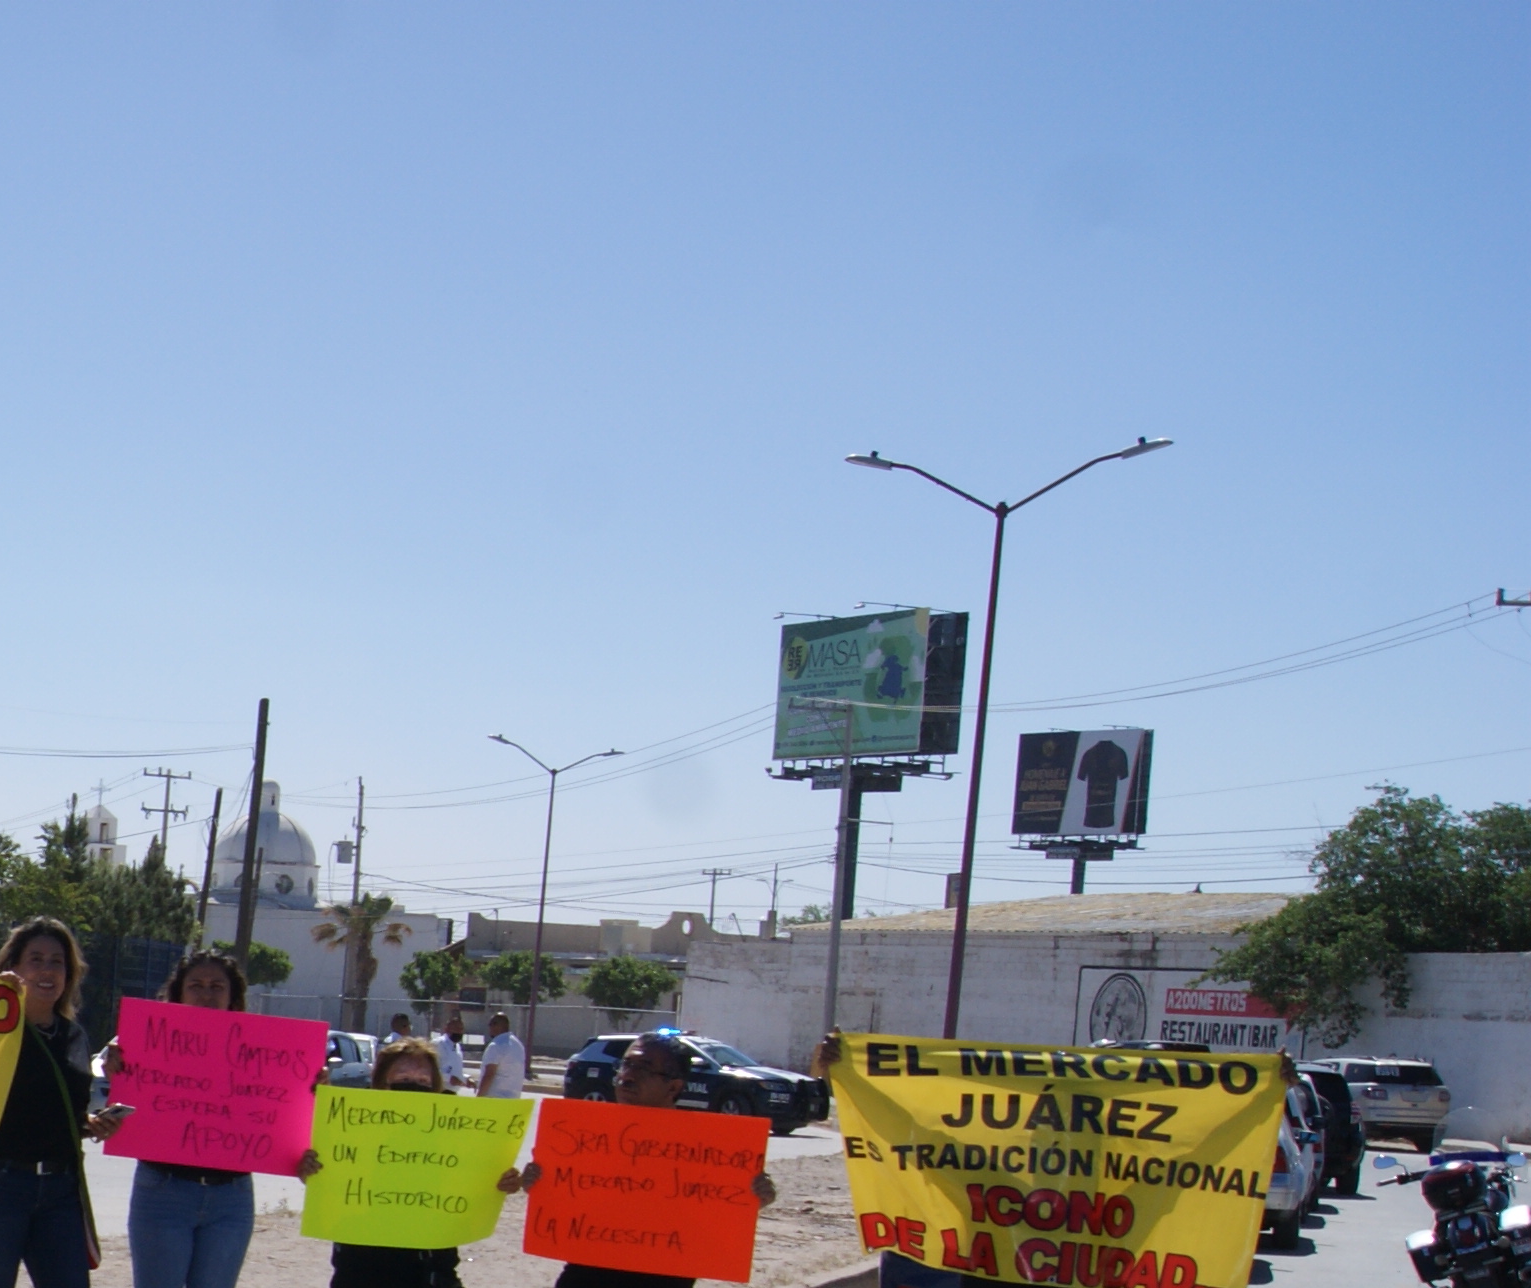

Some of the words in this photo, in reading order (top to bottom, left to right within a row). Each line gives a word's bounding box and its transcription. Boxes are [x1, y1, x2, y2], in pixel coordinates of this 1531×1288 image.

[808, 639, 862, 668] MASA
[144, 1015, 209, 1062] MARU
[226, 1022, 310, 1081] CAMPOS
[866, 1042, 939, 1077] EL
[958, 1047, 1258, 1095] MERCADO
[125, 1063, 212, 1091] MERCADO
[687, 1082, 708, 1093] VIAL
[152, 1094, 231, 1120] ESPERA
[248, 1109, 278, 1125] SU
[327, 1096, 416, 1132] MERCADO
[421, 1103, 497, 1134] JUÁREZ
[507, 1114, 525, 1139] ES
[941, 1084, 1178, 1143] JUÁREZ
[181, 1121, 274, 1161] APOYO
[332, 1144, 357, 1164] UN
[377, 1144, 459, 1168] EDIFICIO
[550, 1120, 610, 1156] SRA
[619, 1123, 765, 1173] GOBERNADORA
[554, 1166, 655, 1197] MERCADO
[845, 1136, 883, 1163] ES
[891, 1140, 1093, 1177] TRADICIÓN
[1104, 1152, 1267, 1200] NACIONAL
[345, 1177, 468, 1214] HISTORICO
[966, 1183, 1134, 1239] ICONO
[533, 1207, 557, 1244] LA
[568, 1213, 684, 1254] NECESITA
[860, 1212, 926, 1260] DE
[940, 1228, 999, 1276] LA
